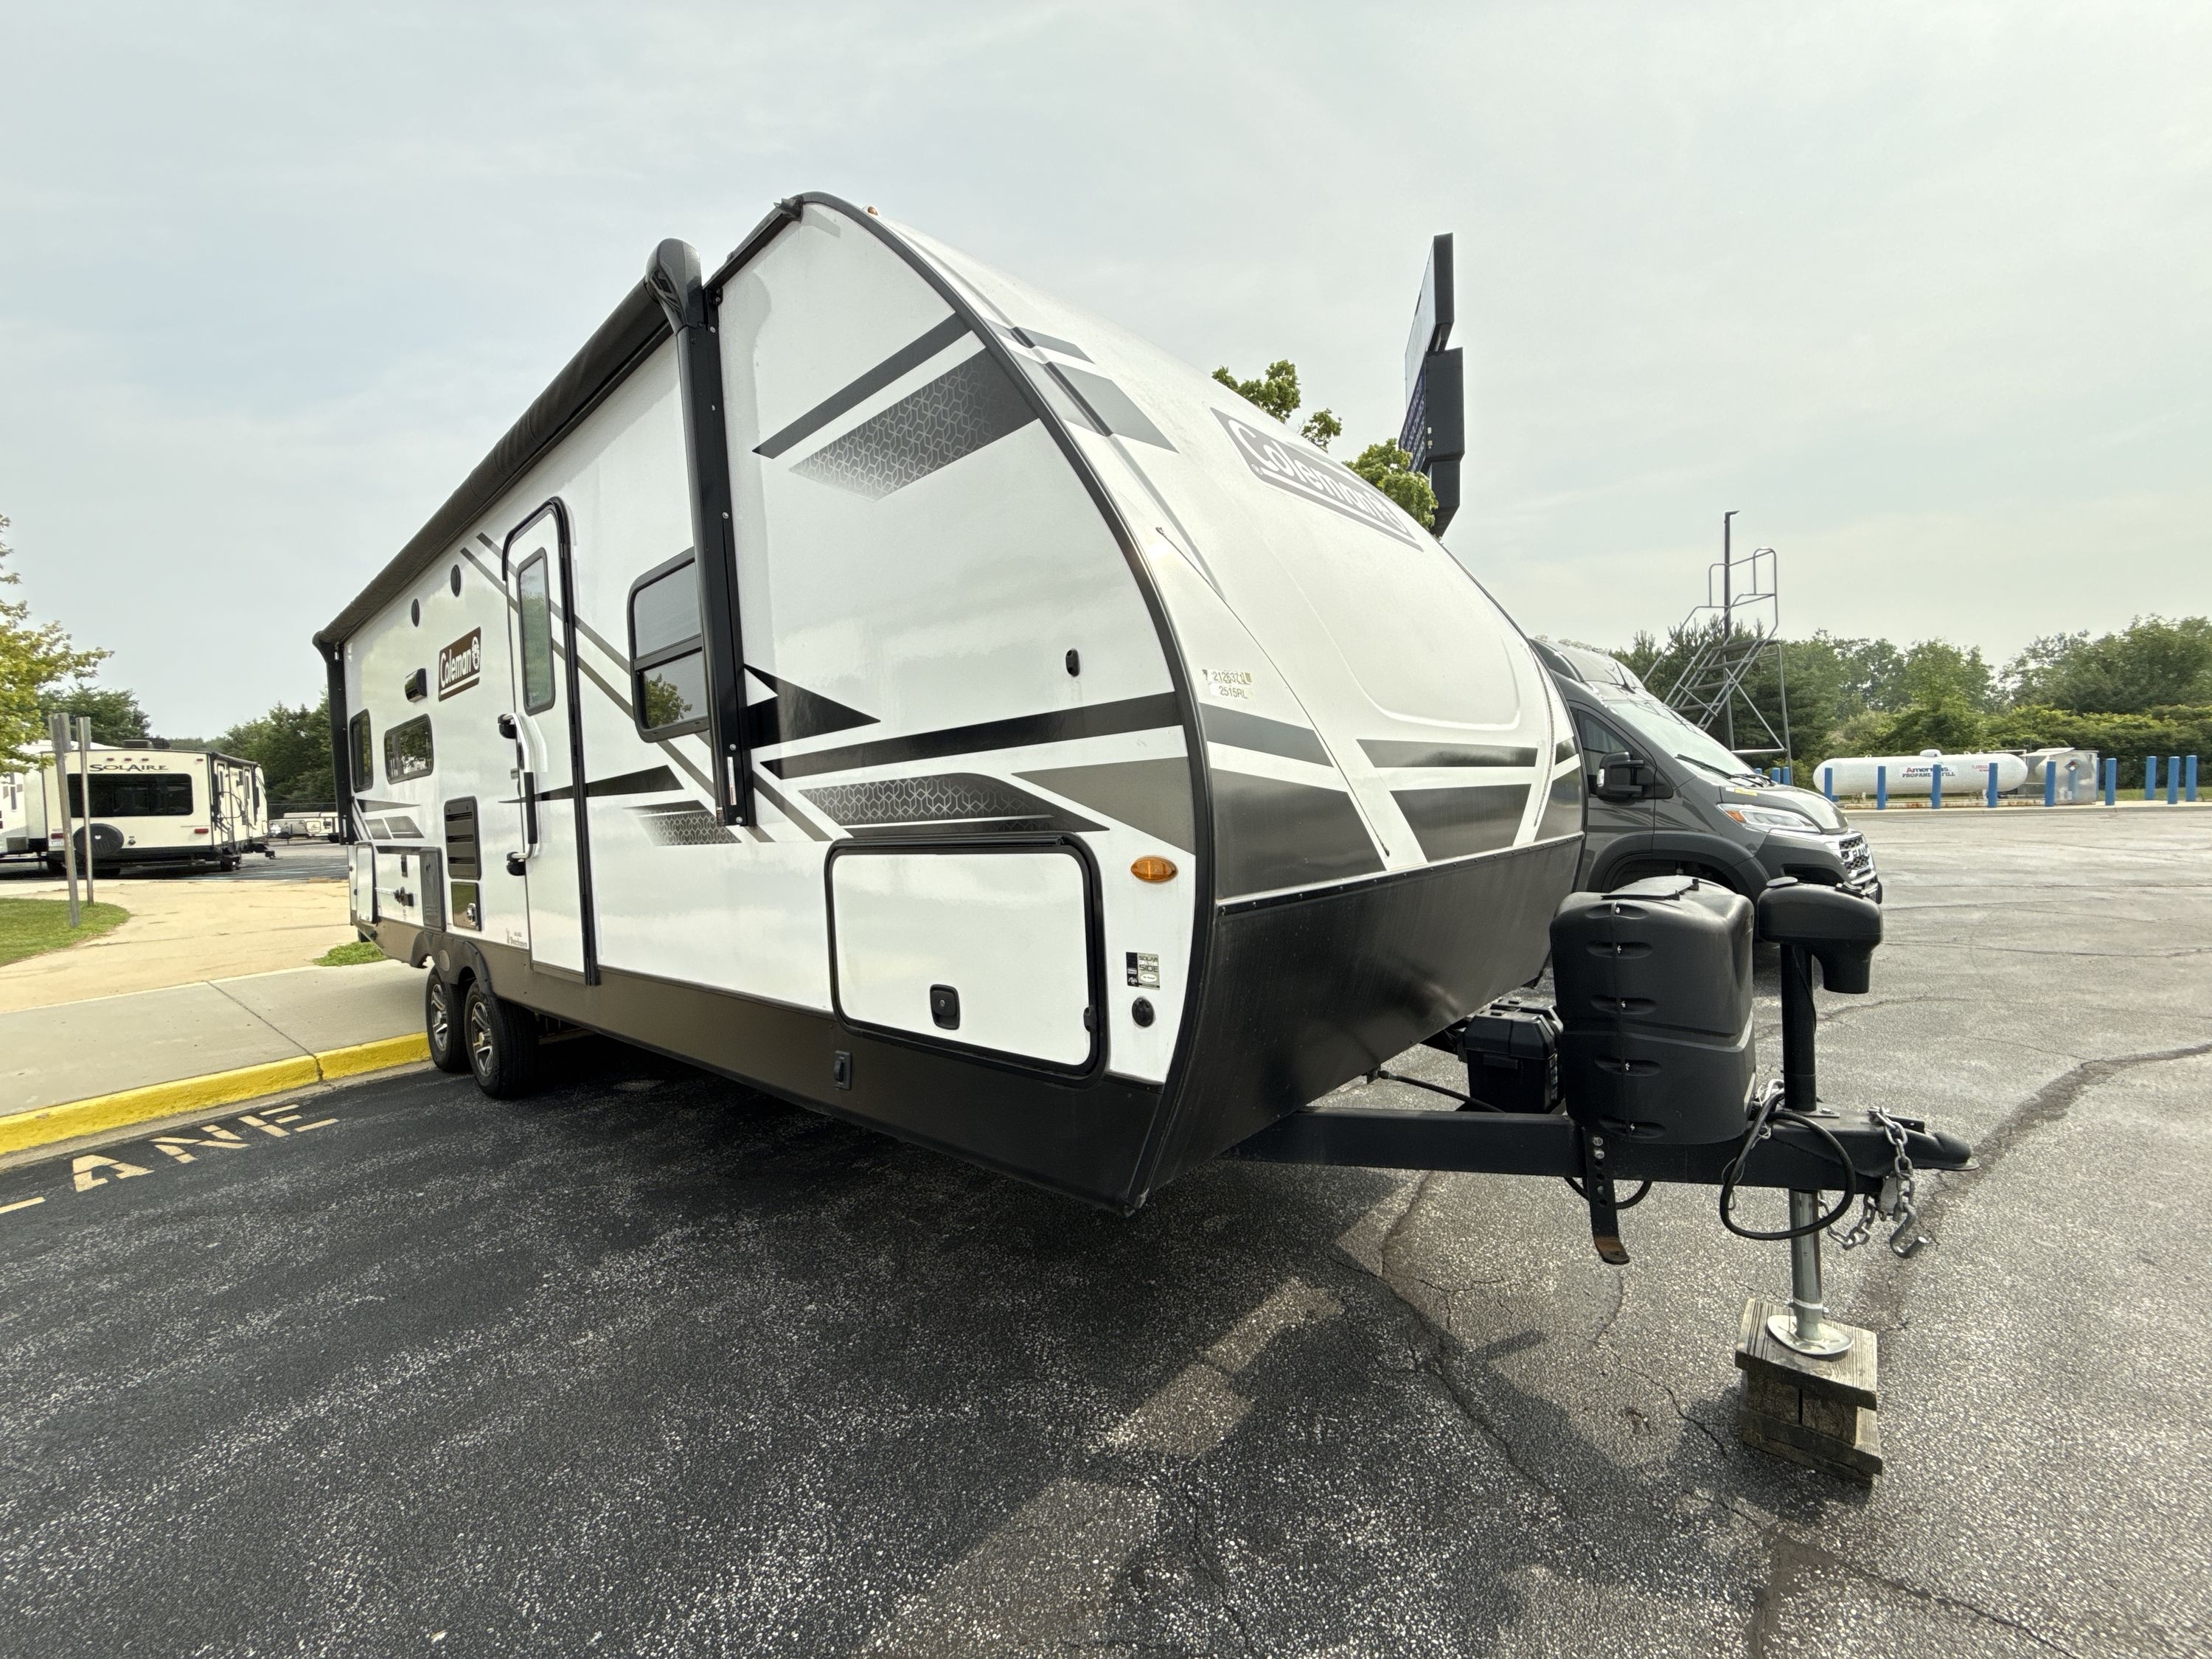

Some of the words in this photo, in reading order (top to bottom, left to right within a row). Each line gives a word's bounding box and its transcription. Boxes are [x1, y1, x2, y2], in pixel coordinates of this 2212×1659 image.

[1228, 420, 1387, 522] Coleman
[440, 649, 472, 688] Coleman
[1138, 964, 1158, 973] SIDE
